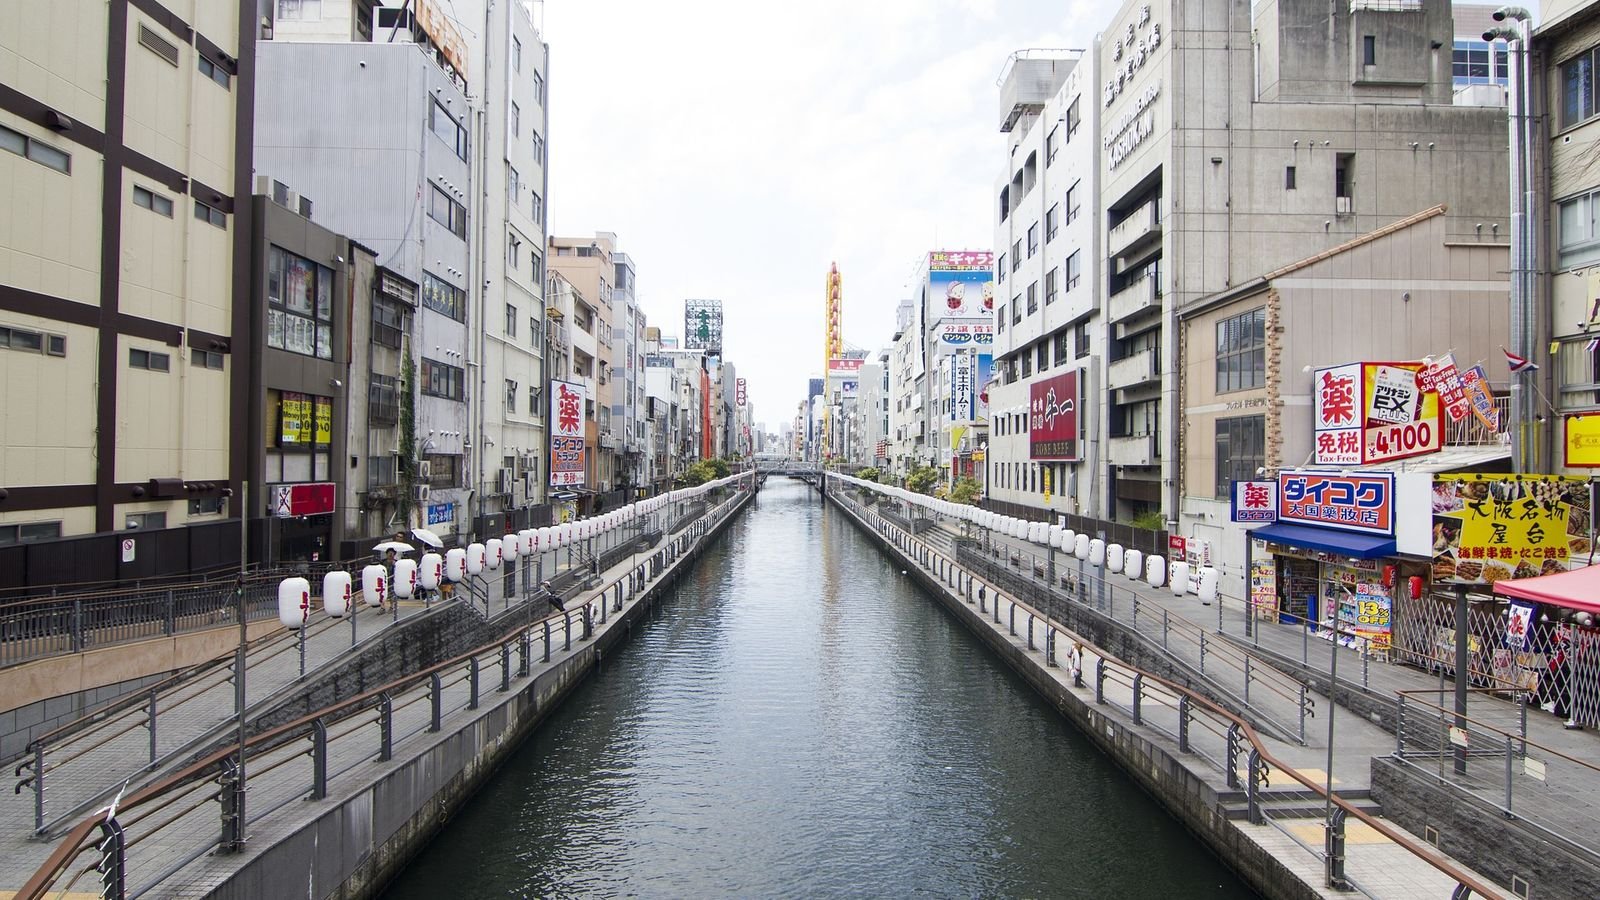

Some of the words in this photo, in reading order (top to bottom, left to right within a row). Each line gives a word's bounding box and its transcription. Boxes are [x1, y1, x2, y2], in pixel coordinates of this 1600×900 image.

[1417, 370, 1430, 379] NO
[1322, 371, 1354, 424] 薬
[1376, 385, 1411, 399] アリナミン
[559, 383, 580, 433] 薬
[1373, 394, 1410, 413] EX
[1035, 441, 1052, 455] KOBE
[1052, 441, 1070, 455] BEEF
[1318, 431, 1359, 454] 免税
[1319, 455, 1358, 463] Tax-Free
[1245, 481, 1269, 509] 薬
[1284, 477, 1385, 509] ダイコク
[1468, 499, 1566, 521] 大阪名物
[1488, 522, 1545, 545] 屋台
[1358, 601, 1390, 617] 13%
[1357, 615, 1390, 626] OFF
